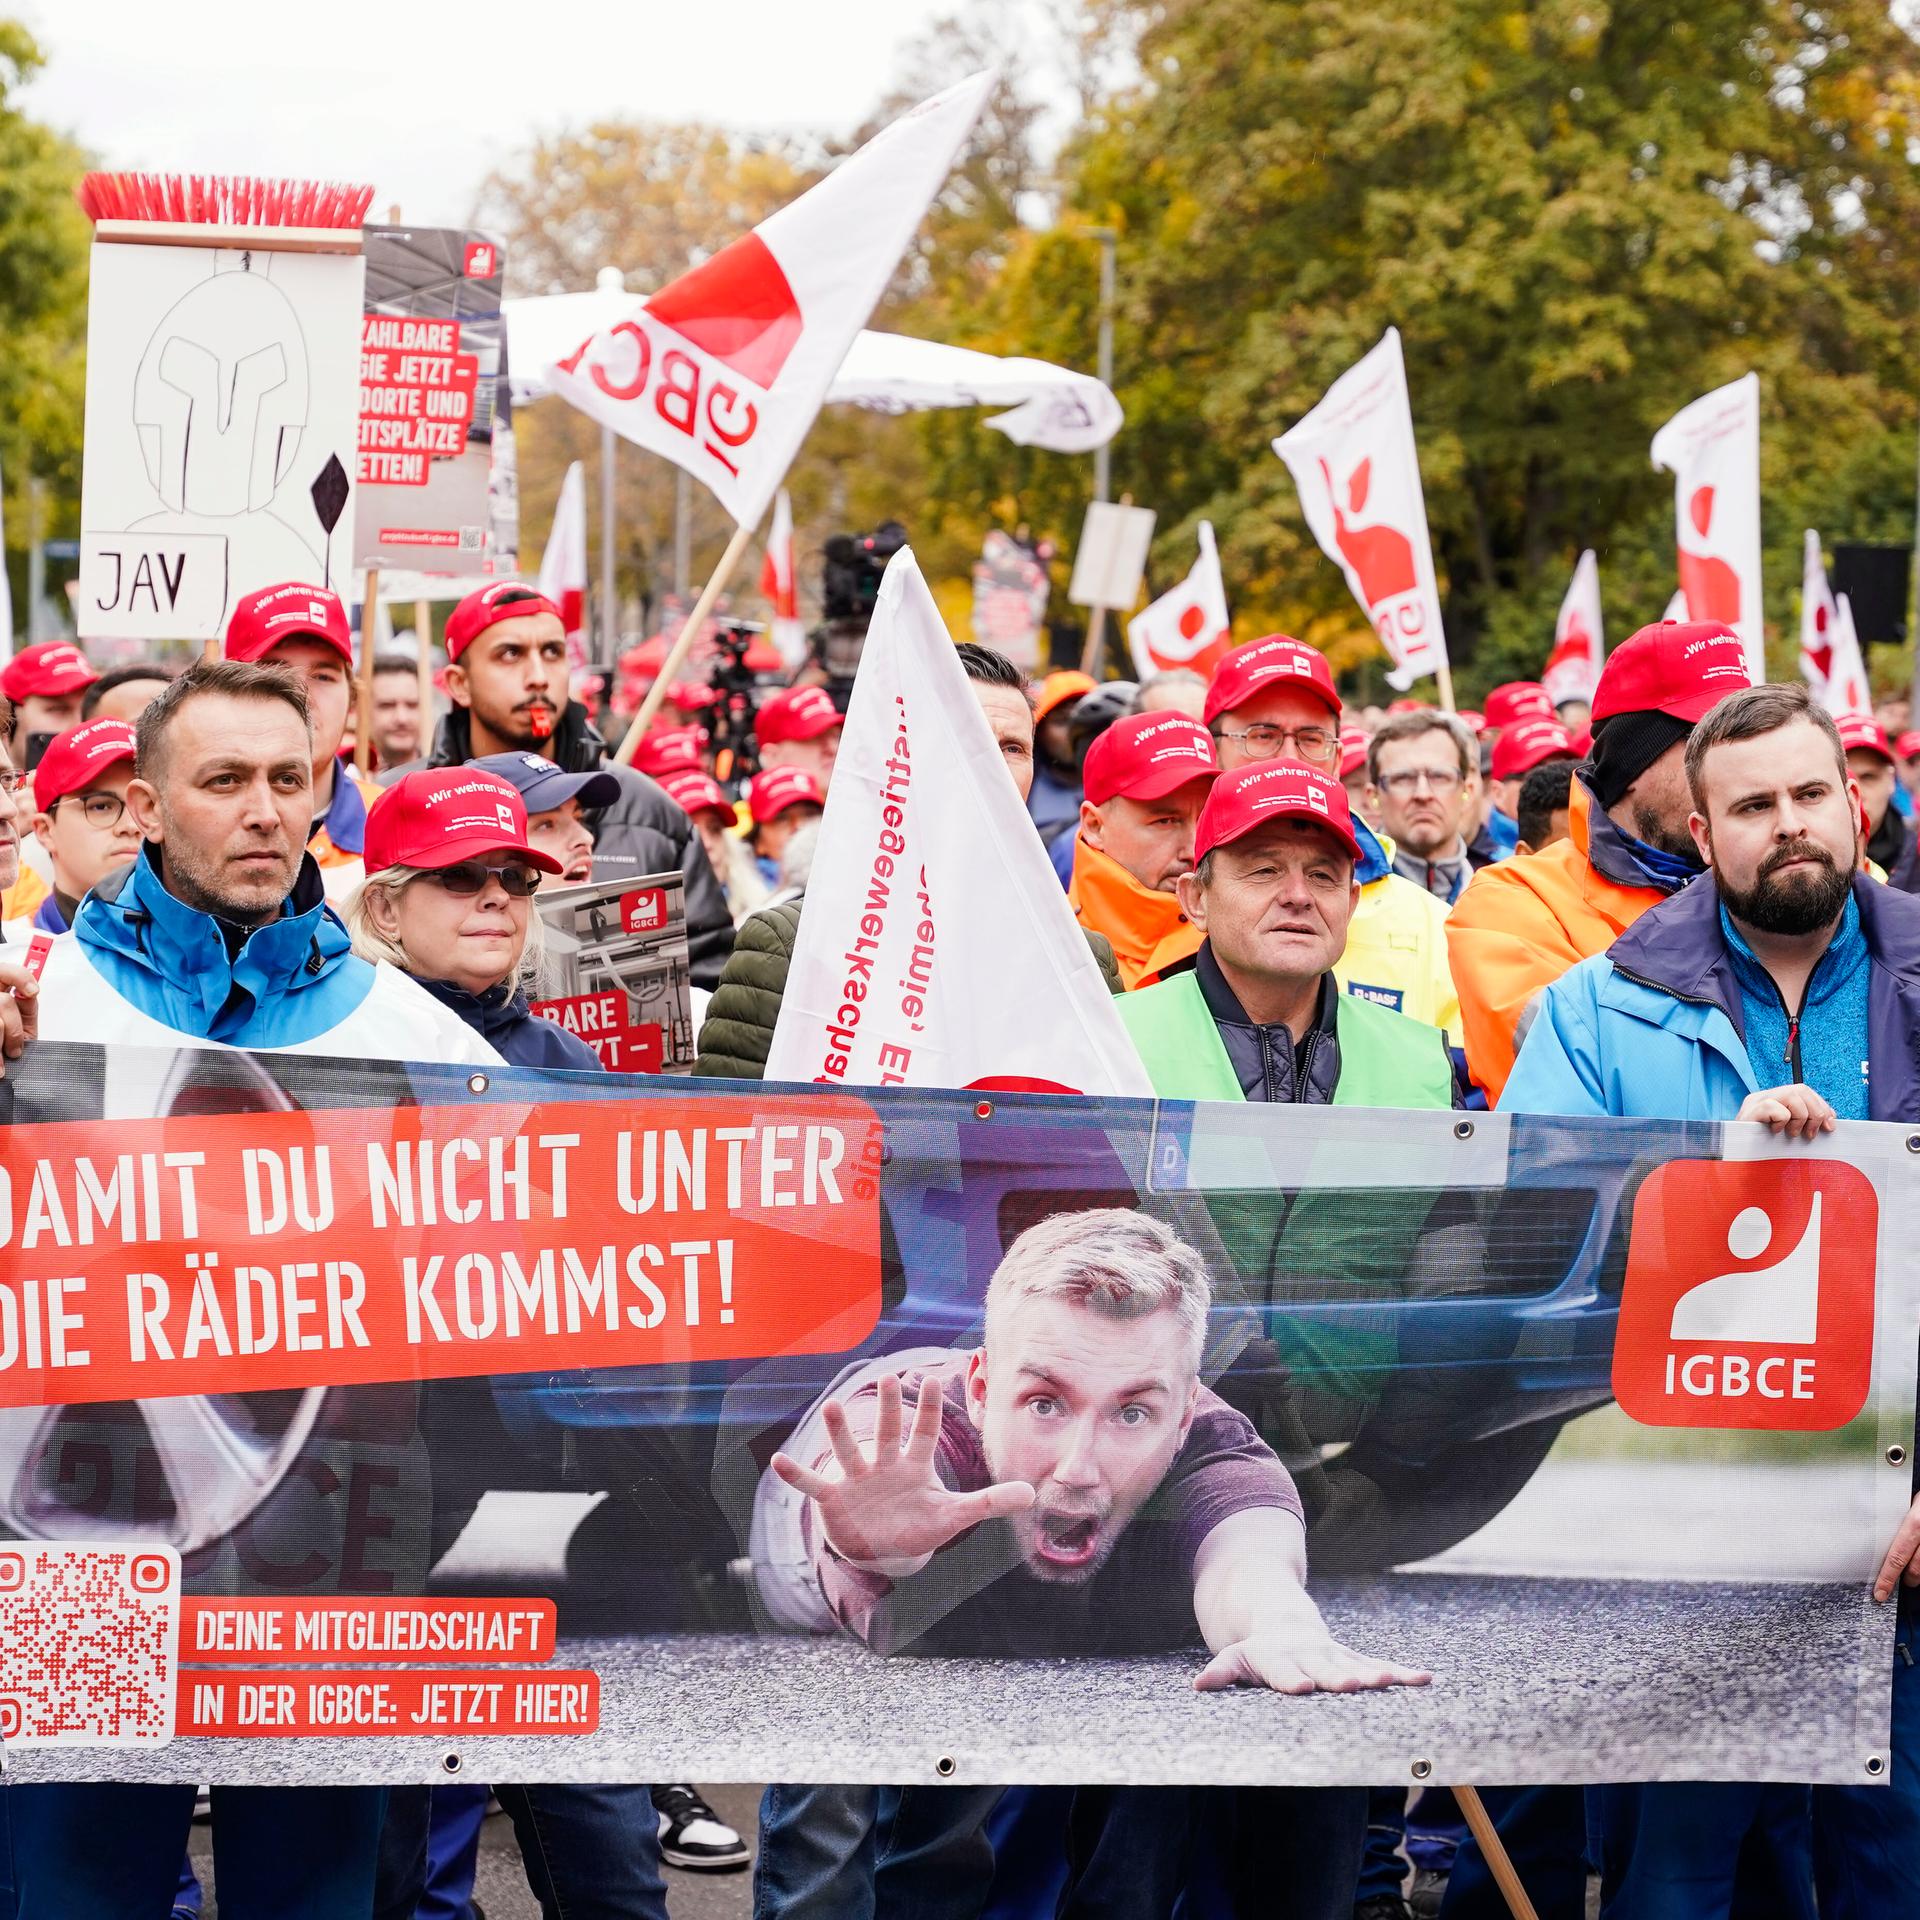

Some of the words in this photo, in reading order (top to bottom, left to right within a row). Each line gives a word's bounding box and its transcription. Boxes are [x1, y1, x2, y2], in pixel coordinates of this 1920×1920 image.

[393, 356, 454, 385] JETZT
[359, 386, 422, 416] DORTE
[426, 389, 467, 419] UND
[357, 452, 425, 482] ETTEN!
[96, 552, 186, 614] JAV
[453, 780, 497, 795] wehren
[1263, 766, 1311, 779] wehren
[630, 916, 660, 930] IGBCE
[531, 997, 618, 1035] BARE
[584, 1034, 622, 1067] ZT
[0, 1151, 206, 1250] AMIT
[241, 1145, 334, 1236] DU
[366, 1132, 580, 1229] NICHT
[616, 1125, 845, 1215] UNTER
[125, 1251, 371, 1363] RÄDER
[402, 1239, 735, 1344] KOMMST!
[1665, 1353, 1816, 1399] IGBCE
[195, 1610, 284, 1651] DEINE
[295, 1610, 545, 1652] MITGLIEDSCHAFT
[192, 1683, 225, 1725] IN
[237, 1683, 297, 1725] DER
[309, 1683, 398, 1725] IGBCE:
[410, 1683, 503, 1724] JETZT
[515, 1683, 589, 1724] HIER!
